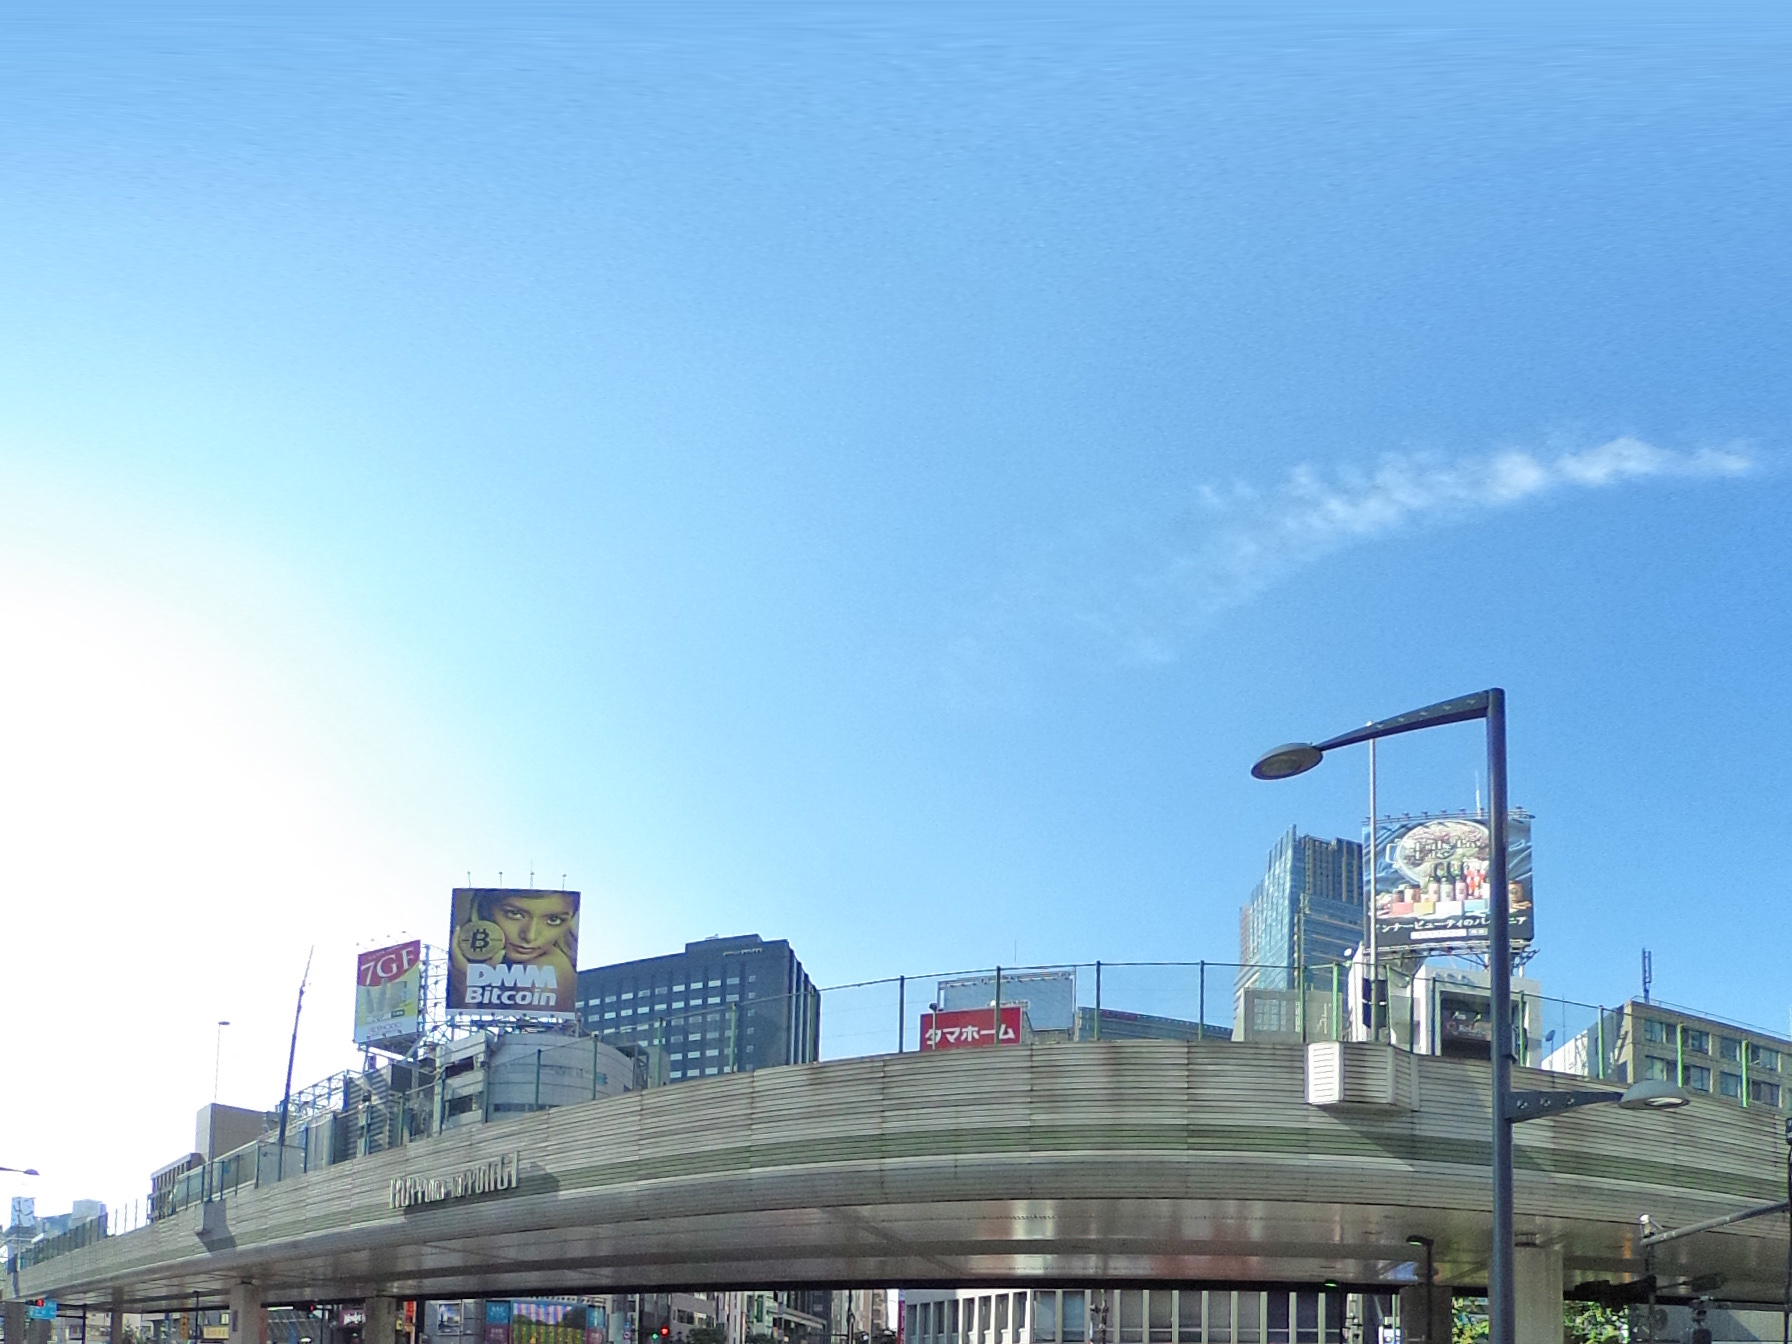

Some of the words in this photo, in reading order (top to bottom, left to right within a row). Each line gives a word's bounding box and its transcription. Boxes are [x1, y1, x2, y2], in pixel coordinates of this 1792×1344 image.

[361, 946, 415, 986] 7GF
[467, 963, 557, 988] DMM
[465, 987, 557, 1006] Bitcoin
[925, 1023, 1016, 1045] タマホーム
